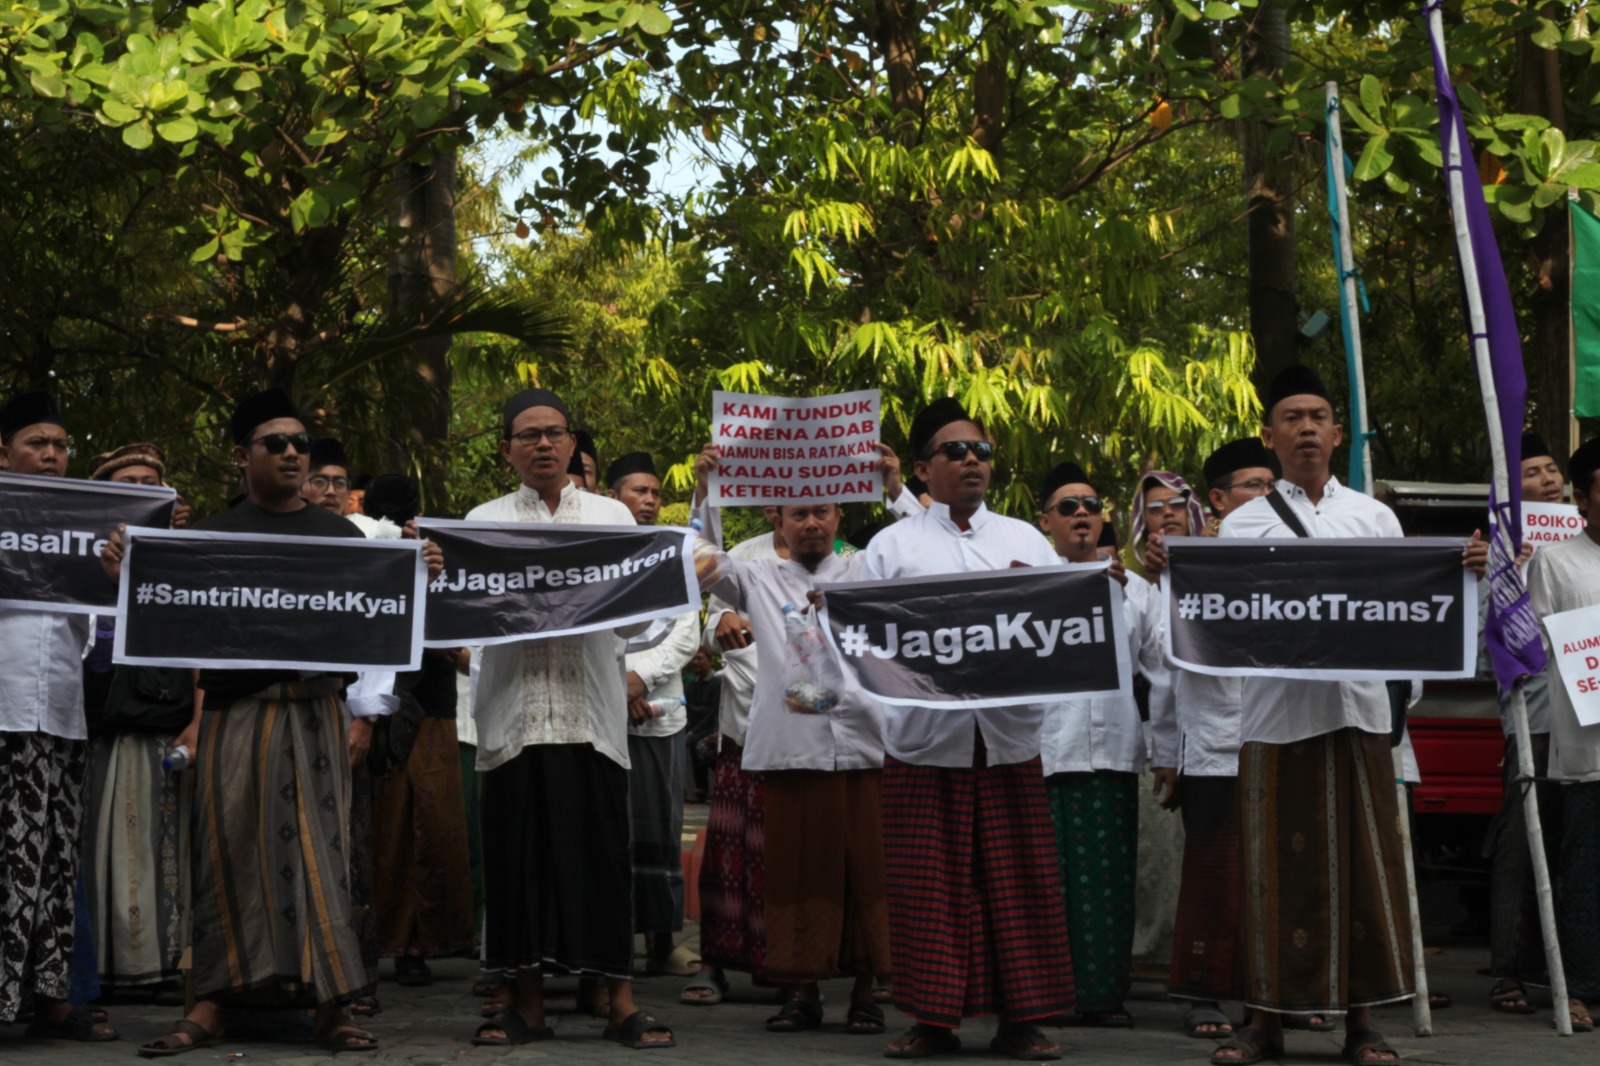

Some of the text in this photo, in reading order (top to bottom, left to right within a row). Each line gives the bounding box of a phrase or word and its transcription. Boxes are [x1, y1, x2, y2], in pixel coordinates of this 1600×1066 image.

[723, 400, 872, 421] KAMI TUNDUK
[719, 420, 874, 441] KARENA ADAB
[715, 439, 877, 460] NAMUN BISA RATAKAN
[718, 461, 874, 479] KALAU SUDAH
[720, 480, 873, 498] KETERLALUAN
[1527, 531, 1560, 542] JAGA
[428, 544, 676, 595] #JagaPesantren
[136, 583, 407, 618] #SantriNderekKyai
[1178, 593, 1454, 622] #BoikotTrans7
[839, 606, 1106, 665] #JagaKyai
